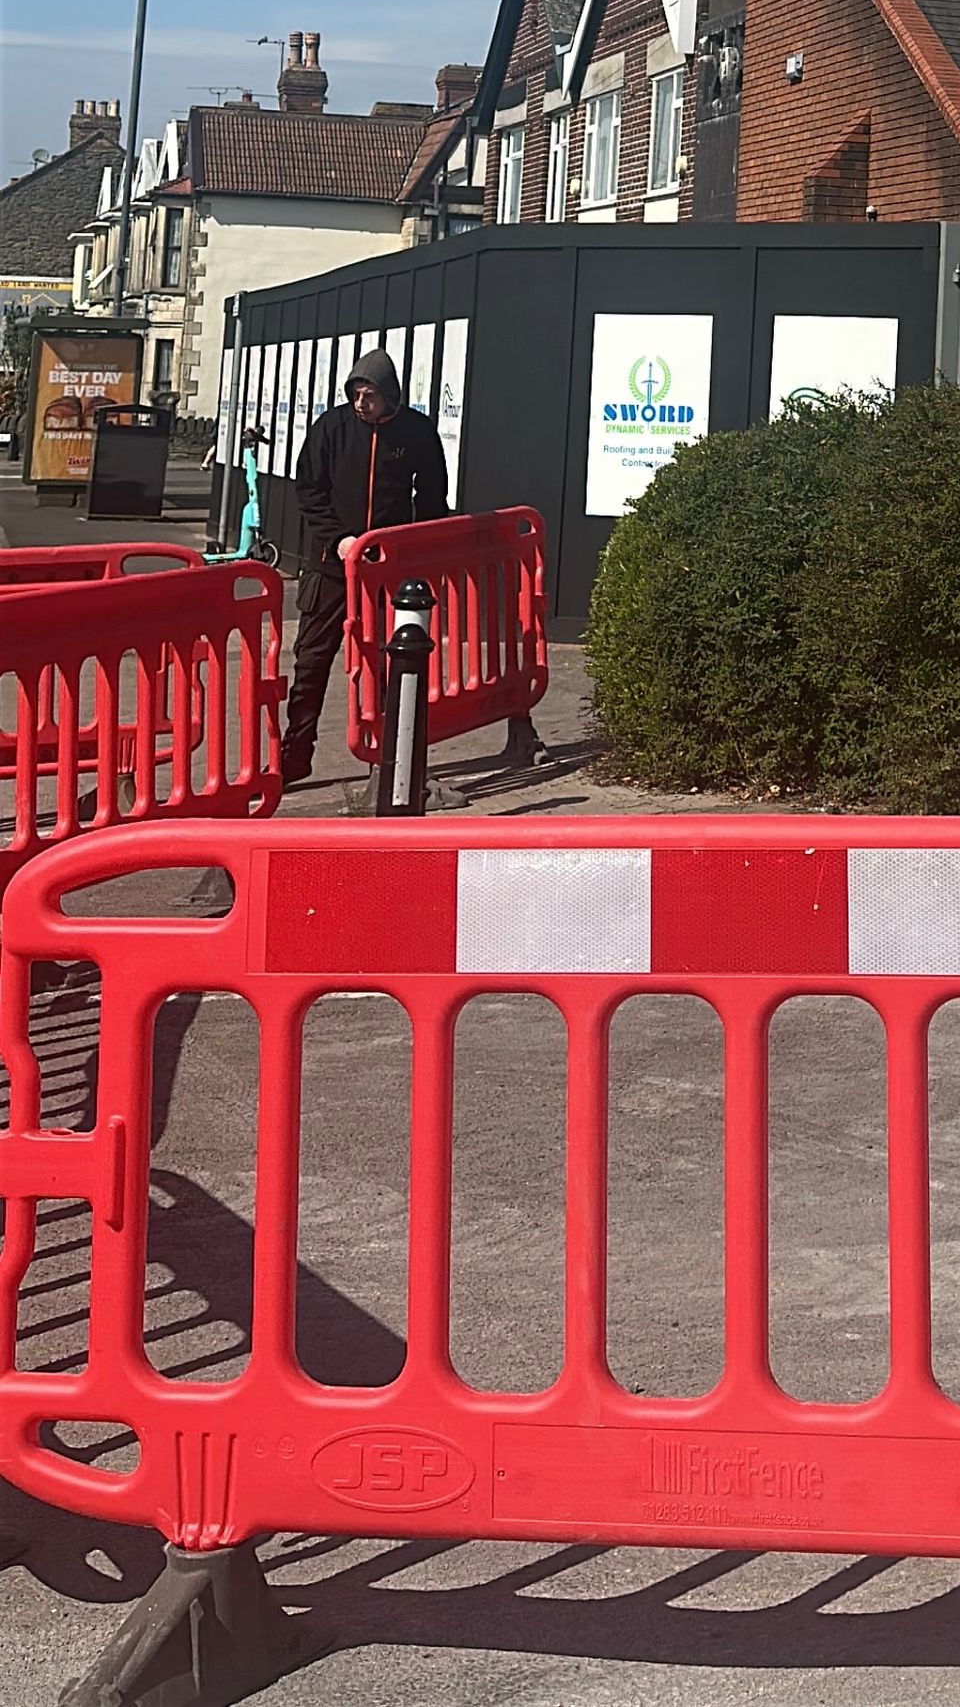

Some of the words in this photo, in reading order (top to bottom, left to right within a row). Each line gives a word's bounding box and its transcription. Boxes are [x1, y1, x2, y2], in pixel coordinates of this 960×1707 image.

[48, 370, 89, 384] BEST
[92, 371, 122, 385] DAY
[63, 384, 106, 397] EVER
[603, 403, 694, 423] SWORD
[605, 424, 645, 435] DYNAMIC
[650, 425, 691, 436] SERVICES
[603, 444, 636, 456] Roofing
[638, 446, 654, 455] and
[656, 446, 673, 455] Buil
[332, 1443, 448, 1492] JSP
